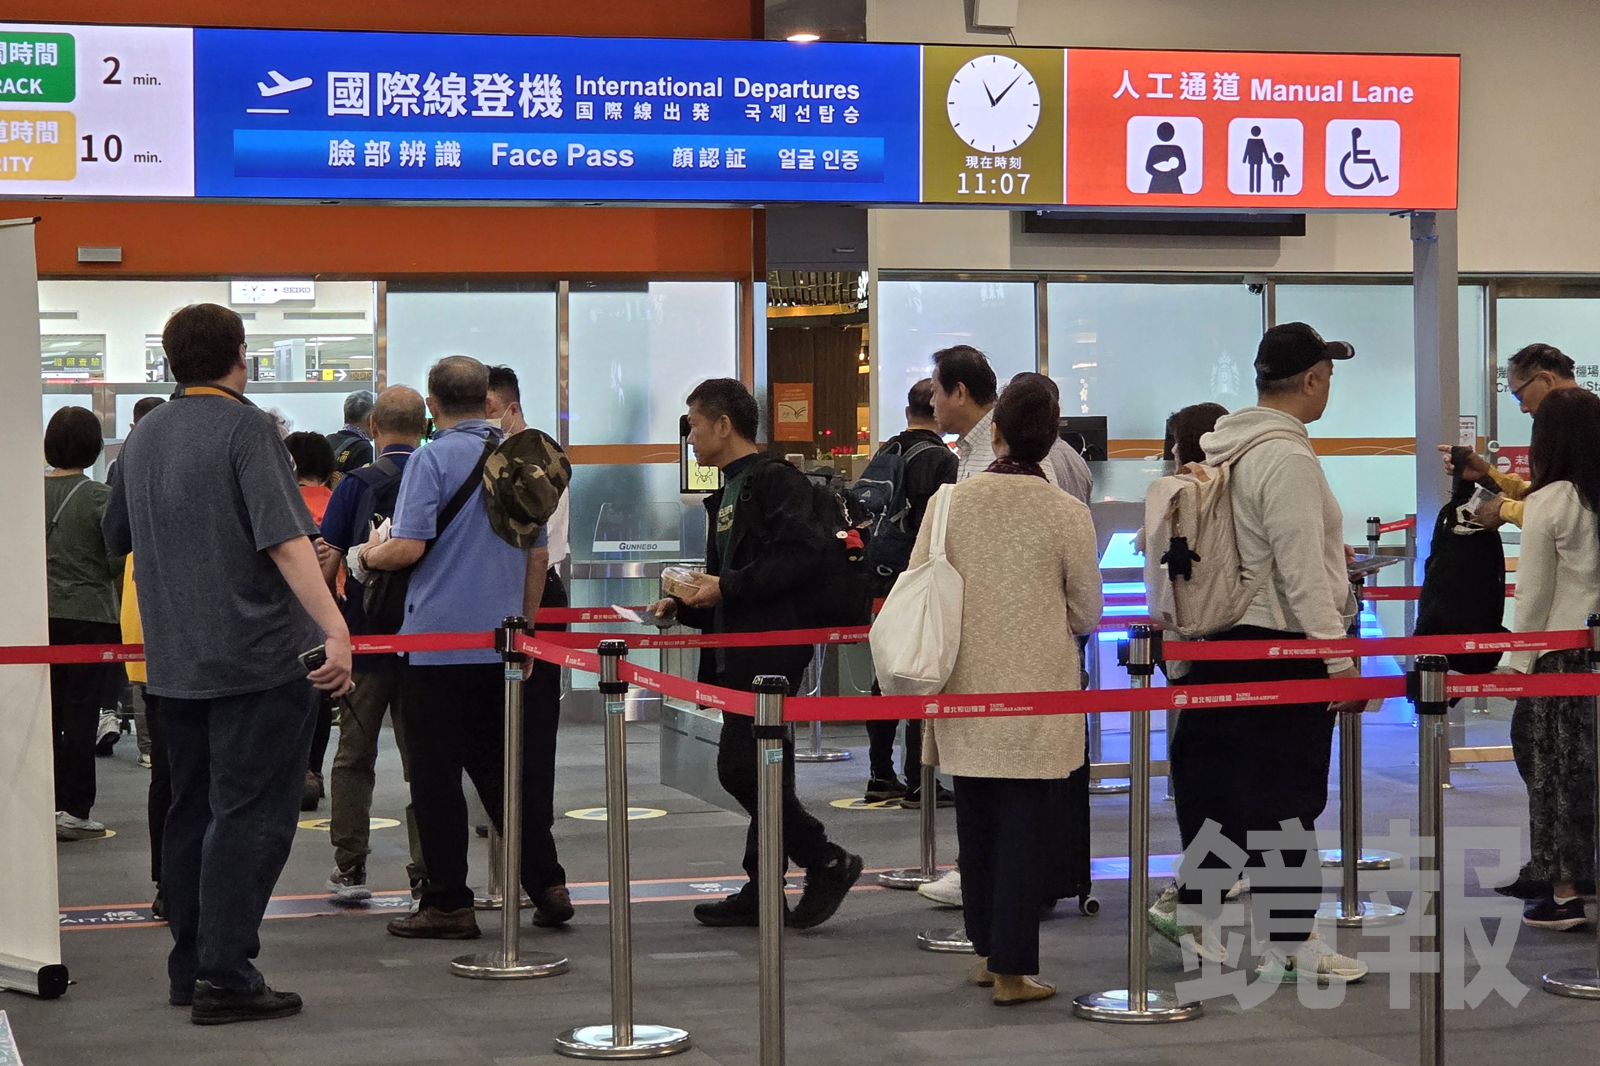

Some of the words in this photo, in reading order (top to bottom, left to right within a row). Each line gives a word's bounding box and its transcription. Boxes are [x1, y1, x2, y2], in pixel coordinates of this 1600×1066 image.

[102, 56, 122, 85] 2
[133, 73, 161, 86] min.
[327, 71, 564, 119] 國際線登機
[576, 75, 723, 97] International
[734, 78, 860, 103] Departures
[1112, 69, 1241, 101] 人工通道
[1250, 78, 1344, 103] Manual
[1352, 80, 1415, 104] Lane
[576, 101, 710, 121] 国際線出発
[81, 134, 123, 163] 10
[134, 150, 162, 164] min.
[328, 139, 462, 168] 臉部辨識
[491, 142, 558, 167] Face
[567, 143, 635, 167] Pass
[672, 147, 747, 169] 顔認証
[778, 148, 817, 171] 얼굴
[822, 148, 860, 171] 인증
[0, 156, 33, 173] ITY
[965, 155, 1022, 170] 現在時刻
[957, 172, 1031, 195] 11:07
[282, 286, 311, 294] SEIKO
[618, 542, 658, 551] GUNNEBO
